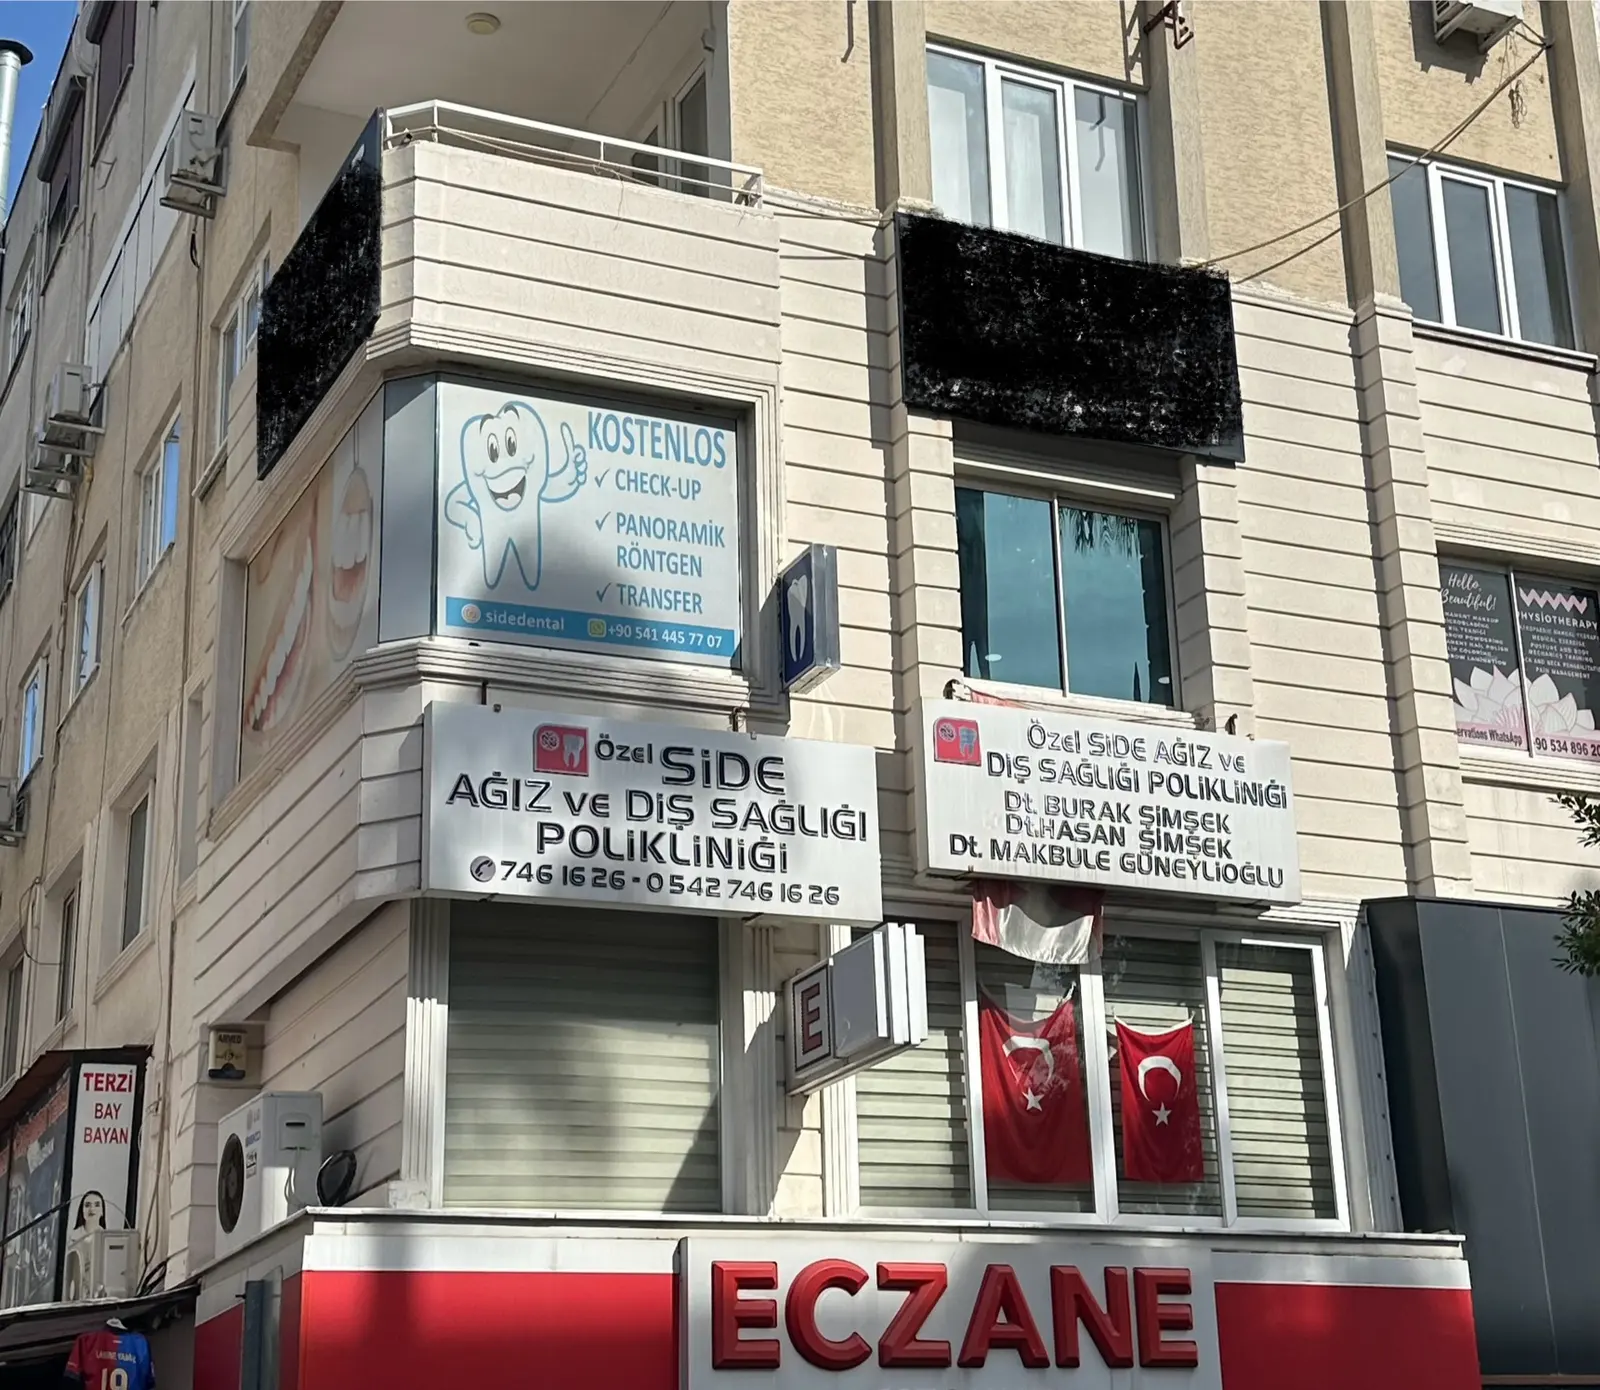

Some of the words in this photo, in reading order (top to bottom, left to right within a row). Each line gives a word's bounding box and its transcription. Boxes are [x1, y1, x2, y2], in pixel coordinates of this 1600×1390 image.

[587, 411, 726, 469] KOSTENLOS
[615, 469, 702, 501] CHECK-UP
[616, 513, 726, 548] PANORAMİK
[616, 542, 703, 578] RÖNTGEN
[616, 582, 704, 615] TRANSFER
[485, 607, 565, 631] sidedental
[607, 623, 632, 639] +90
[635, 627, 657, 641] 541
[662, 629, 685, 645] 445
[688, 632, 703, 646] 77
[706, 634, 723, 648] 07
[1153, 736, 1214, 770] AĞIZ
[1457, 726, 1488, 740] ervations
[1488, 728, 1523, 747] WhatsApp
[1534, 736, 1548, 751] 90
[1550, 738, 1569, 753] 534
[1570, 741, 1589, 756] 896
[1038, 757, 1140, 793] SAĞLIĞI
[446, 771, 553, 814] AĞIZ
[710, 797, 868, 842] SAĞLIĞI
[1004, 790, 1038, 816] Dt.
[1044, 795, 1132, 825] BURAK
[949, 833, 983, 859] Dt.
[990, 837, 1111, 872] MAKBULE
[500, 860, 553, 885] 746
[801, 982, 823, 1055] E
[83, 1069, 133, 1093] TERZİ
[94, 1102, 123, 1120] BAY
[83, 1126, 129, 1144] BAYAN
[711, 1258, 1199, 1371] ECZANE
